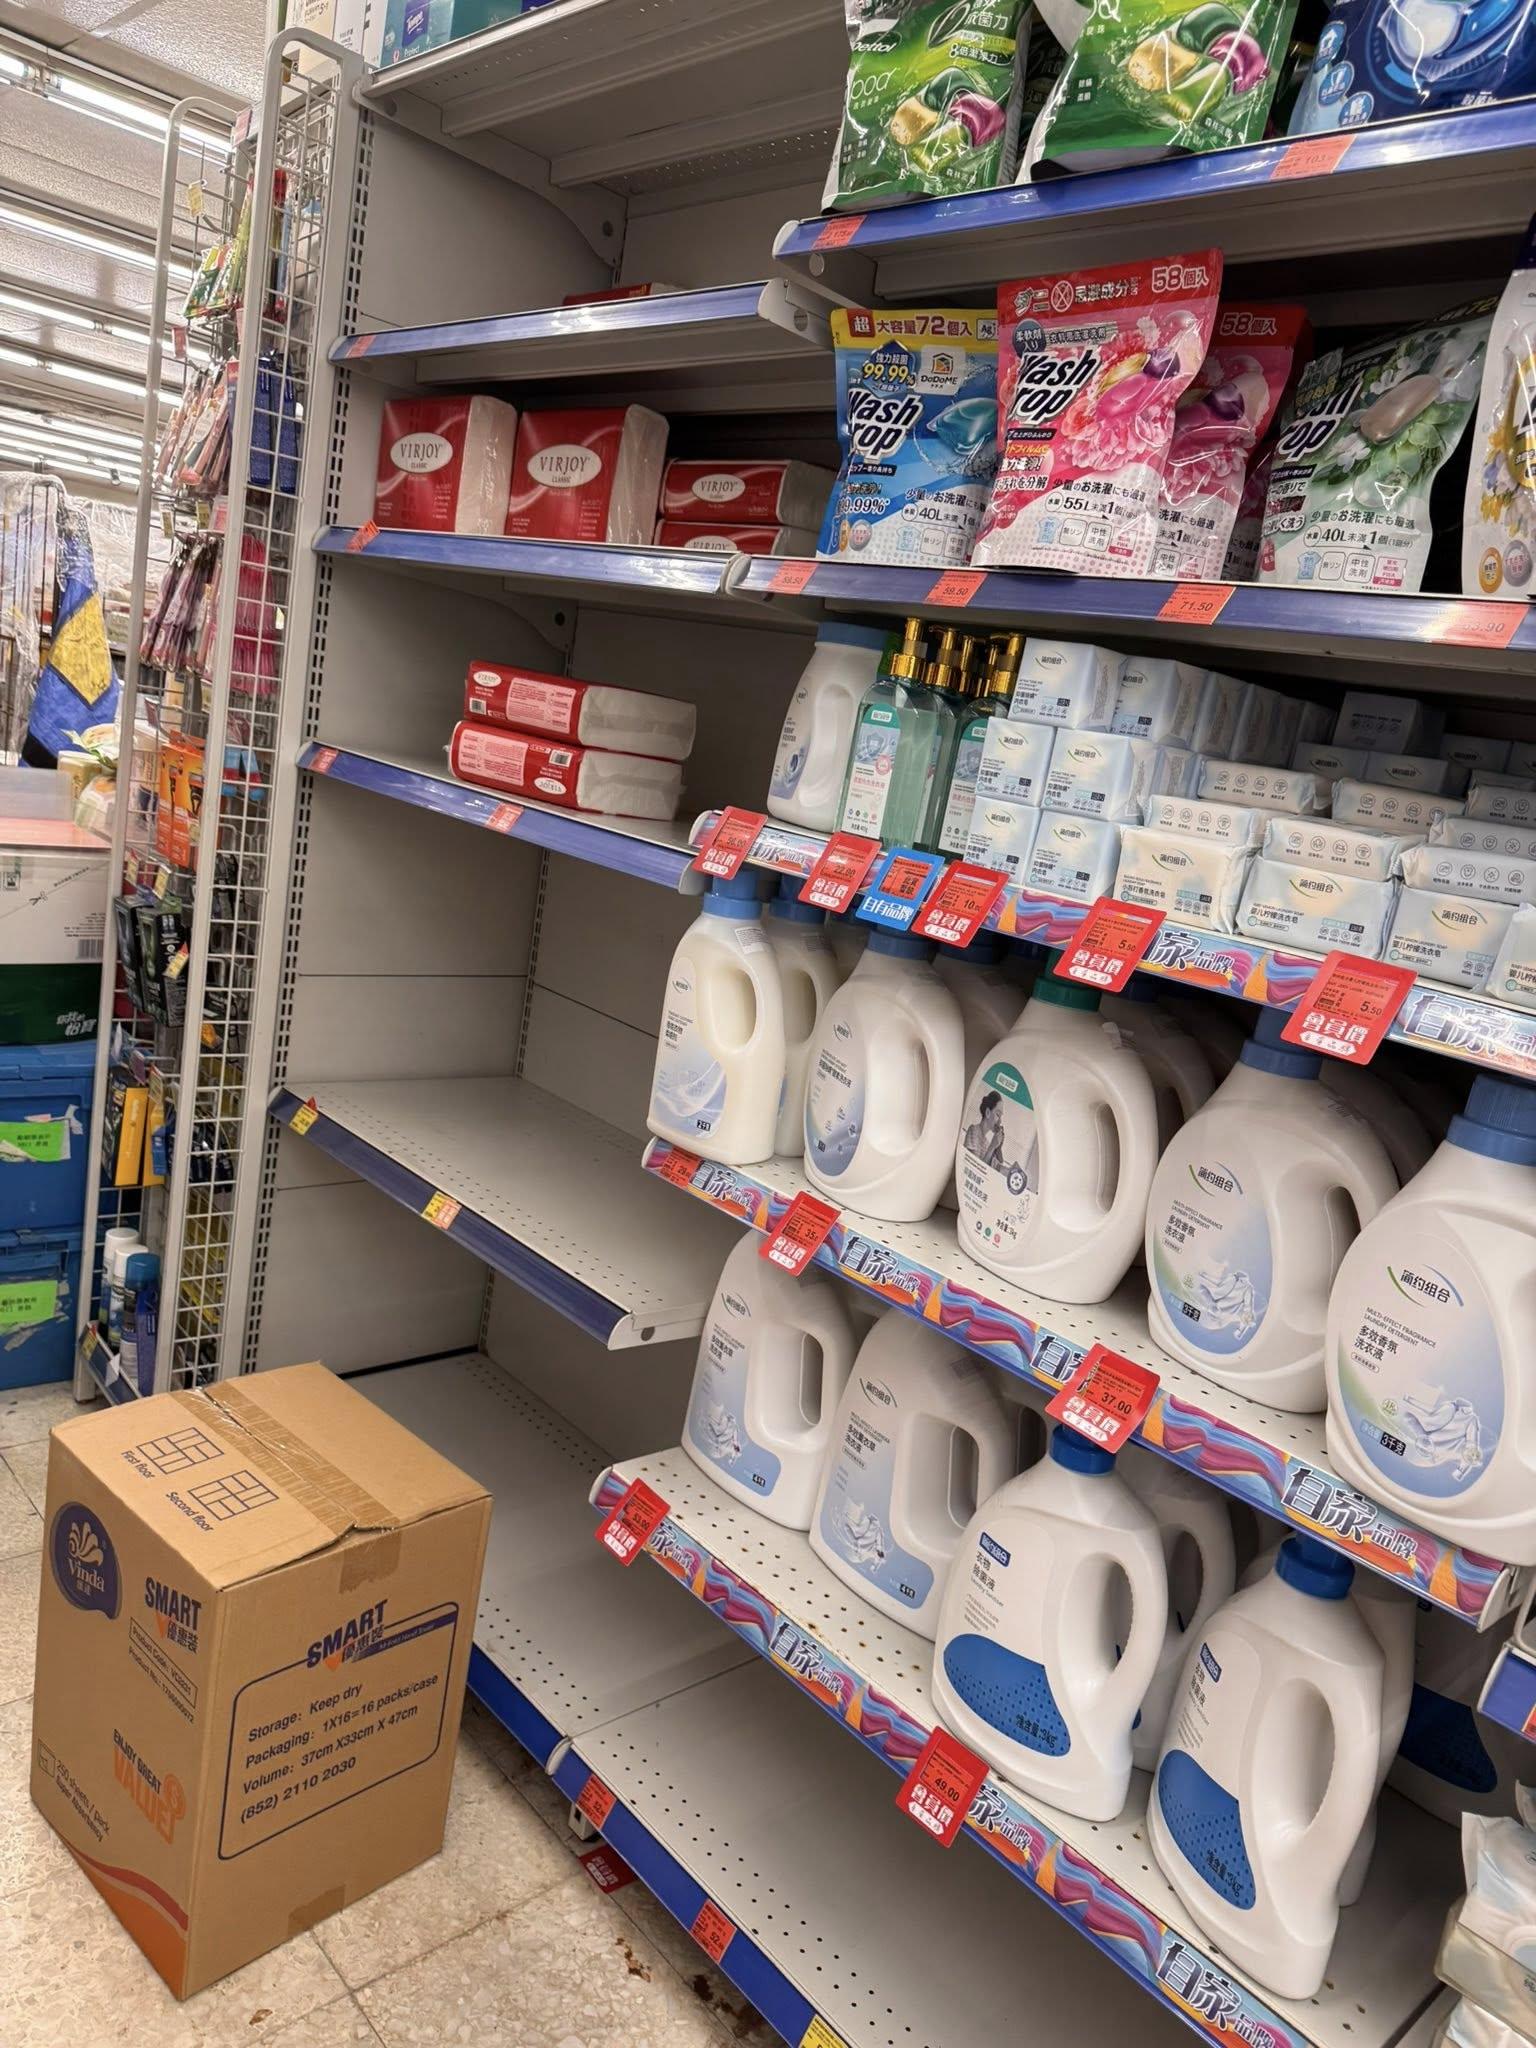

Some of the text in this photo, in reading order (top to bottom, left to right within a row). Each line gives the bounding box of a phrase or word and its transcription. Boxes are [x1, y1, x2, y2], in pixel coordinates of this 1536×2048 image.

[1151, 265, 1209, 292] 58個入
[854, 316, 972, 337] 超 大容量72個入
[1013, 387, 1072, 421] rop
[400, 442, 441, 458] VIRJOY
[539, 455, 588, 472] VIRJOY
[700, 481, 736, 492] VIRJOY
[1092, 527, 1107, 536] 中性
[1348, 568, 1367, 578] 洗剤
[1351, 559, 1369, 568] 中性
[1180, 601, 1213, 611] 71.50
[811, 878, 849, 900] 會員價
[1300, 878, 1334, 894] 简约组合
[862, 896, 915, 922] 自有品牌
[928, 909, 971, 933] 會員價
[1441, 910, 1479, 925] 简约组合
[1072, 950, 1125, 975] 會員價
[1141, 930, 1234, 977] 家品牌
[1392, 940, 1441, 958] 婴儿柠檬洗衣皂
[1360, 1001, 1383, 1016] 5.50
[1302, 1012, 1369, 1046] 會員價
[690, 1160, 751, 1208] 自家品牌
[1198, 1166, 1234, 1193] 简约组合
[840, 1235, 920, 1296] 自家品牌
[1400, 1269, 1450, 1303] 简约组合
[1359, 1325, 1398, 1355] 多效香氛
[1364, 1314, 1418, 1347] LAUNDRY DETERGENT
[1402, 1323, 1437, 1349] FRAGRANCE
[1354, 1336, 1384, 1361] 洗衣液
[1065, 1396, 1121, 1436] 會員價
[1102, 1392, 1132, 1415] 37.00
[1381, 1433, 1405, 1456] 3千克
[121, 1450, 155, 1479] First floor
[166, 1491, 214, 1531] Second floor
[1281, 1467, 1418, 1561] 自家品牌
[650, 1521, 693, 1569] 家品牌
[67, 1557, 105, 1592] Vinda
[144, 1577, 202, 1631] SMART
[307, 1599, 388, 1669] SMART
[770, 1622, 843, 1695] 自家品牌
[245, 1674, 438, 1769] Packaging: 1X16=16 packs/case
[248, 1683, 363, 1743] Storage: Keep dry
[114, 1729, 162, 1794] ENJOY GREAT
[243, 1763, 294, 1794] Volume:
[301, 1743, 333, 1767] 37cm
[377, 1719, 385, 1731] X
[388, 1705, 418, 1725] 47cm
[56, 1760, 70, 1780] 250
[240, 1756, 357, 1824] (852) 2110 2030
[935, 1778, 959, 1802] 49.00
[969, 1784, 1032, 1851] 家品牌
[1156, 1940, 1275, 2048] 自家品牌
